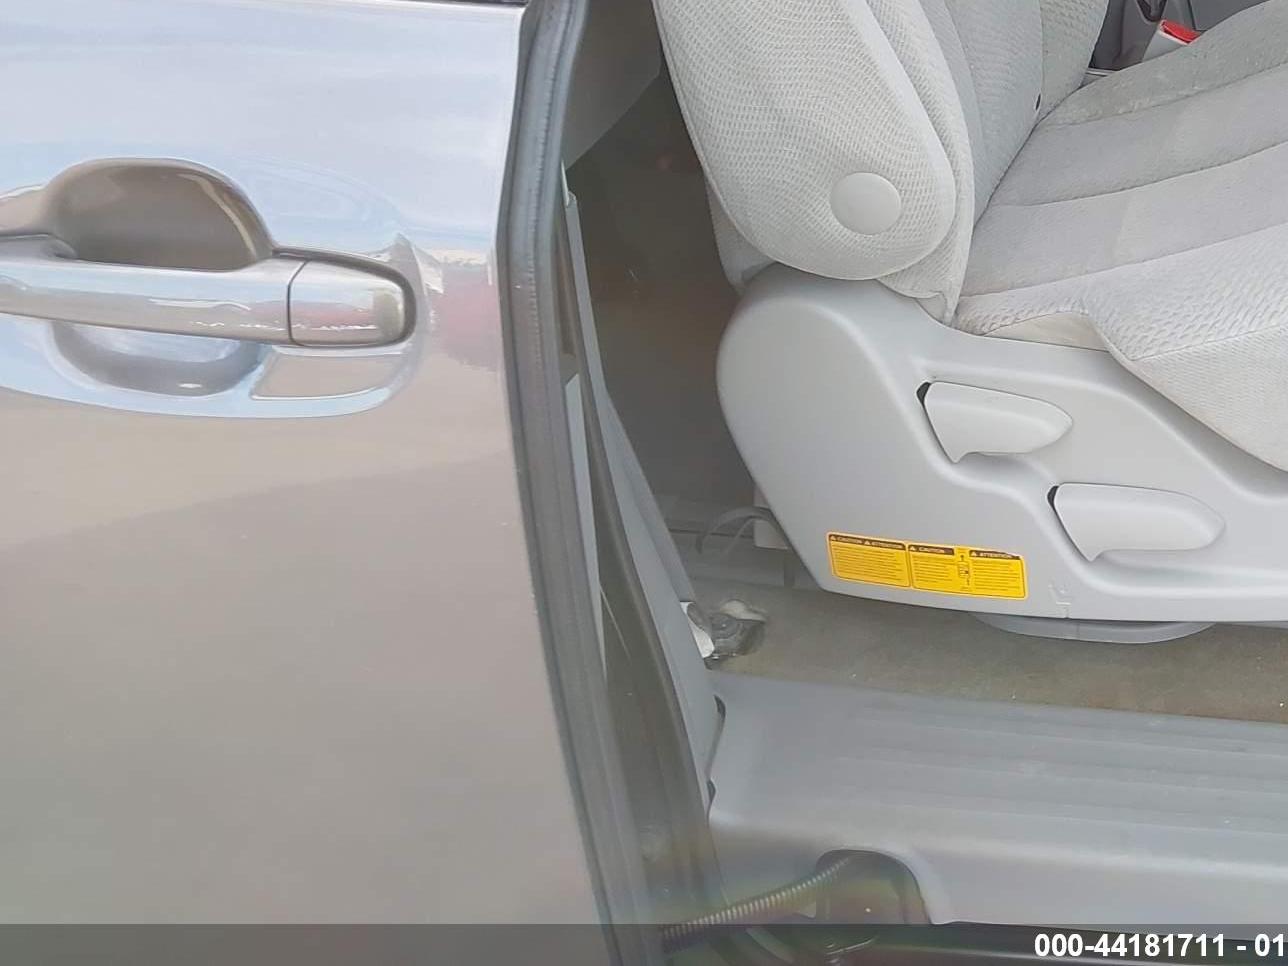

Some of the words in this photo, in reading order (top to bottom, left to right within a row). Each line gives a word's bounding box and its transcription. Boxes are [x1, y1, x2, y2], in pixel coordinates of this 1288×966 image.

[837, 536, 863, 544] CAUTION
[871, 540, 903, 549] ATTENTION
[918, 546, 945, 554] CAUTION
[979, 551, 1013, 559] ATTENTION
